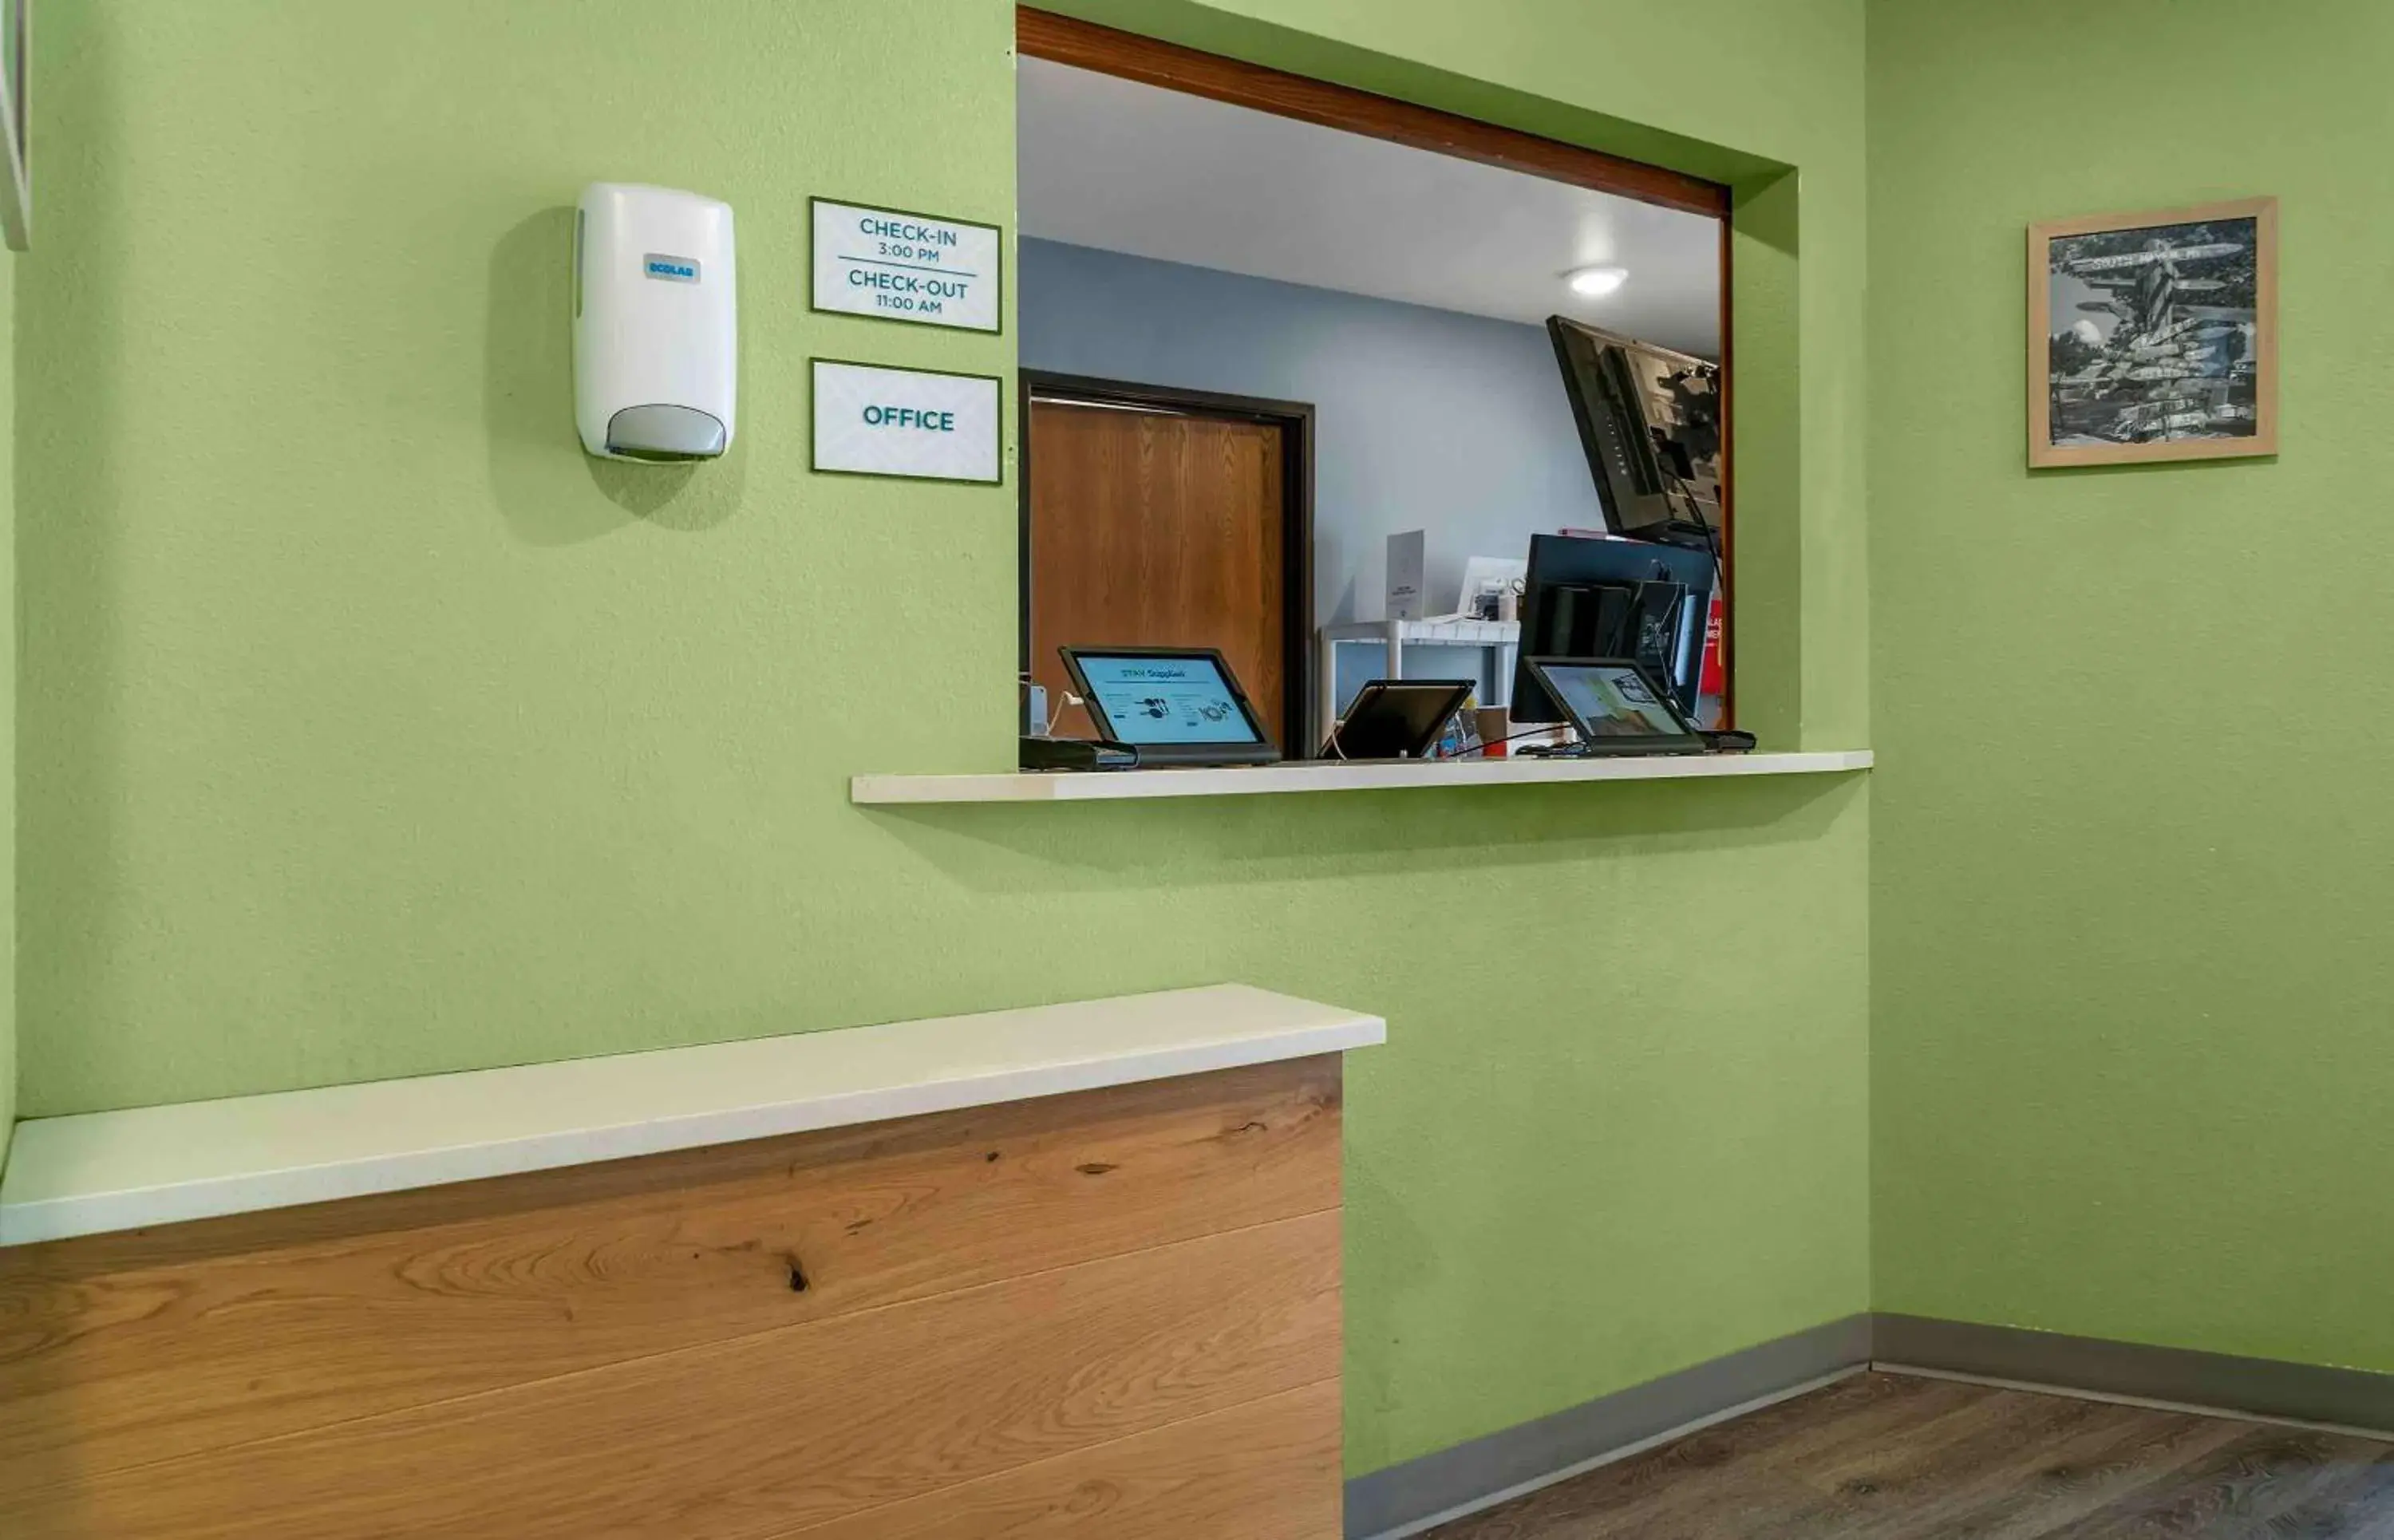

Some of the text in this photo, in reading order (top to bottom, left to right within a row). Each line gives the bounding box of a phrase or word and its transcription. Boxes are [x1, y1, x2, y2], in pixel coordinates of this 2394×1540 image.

[859, 218, 958, 247] CHECK-IN
[879, 242, 940, 263] 3:00 PM
[848, 269, 969, 299] CHECK-OUT
[875, 294, 942, 314] 11:00 AM
[863, 405, 955, 432] OFFICE
